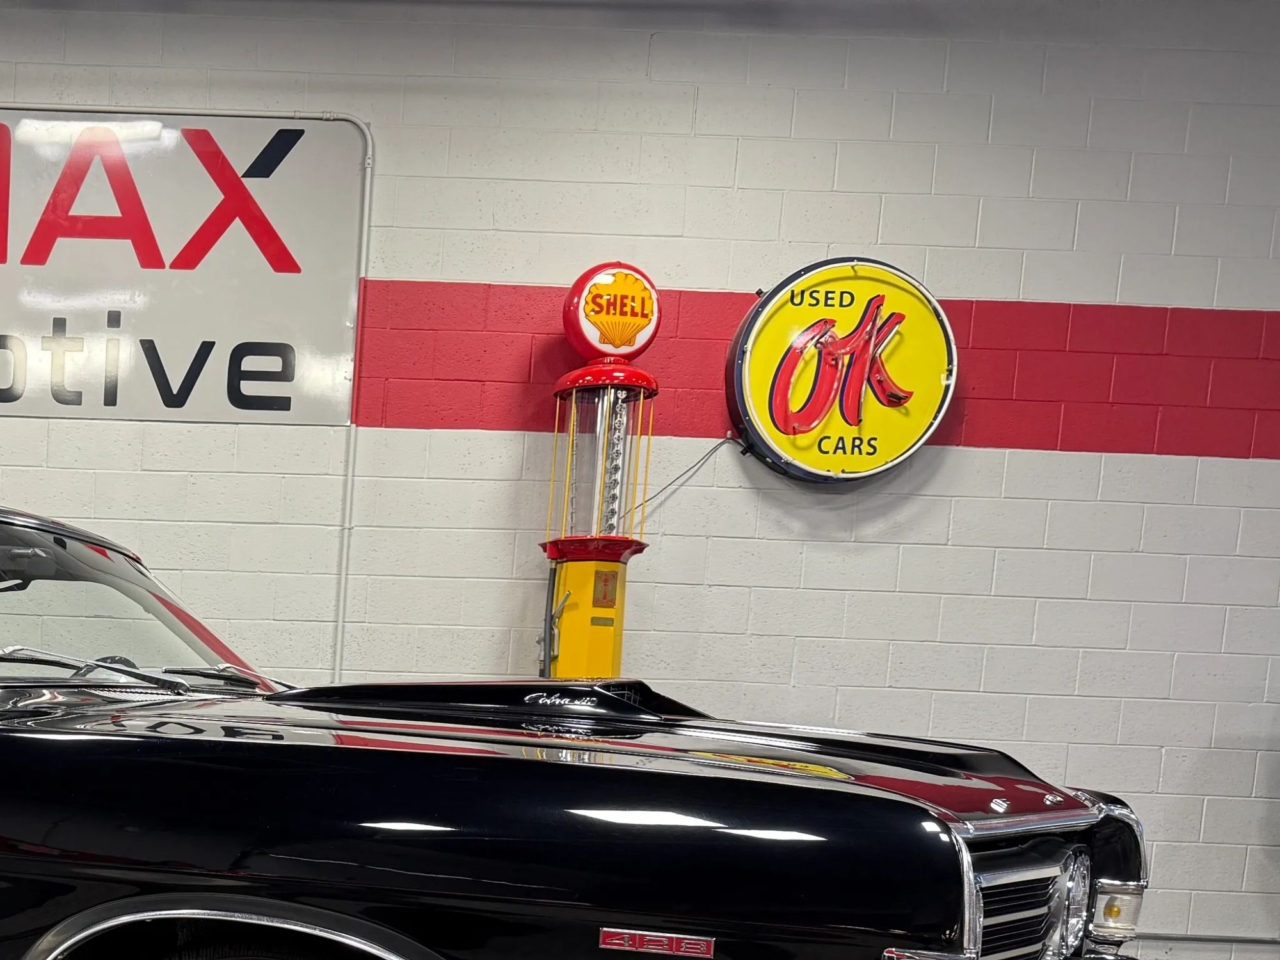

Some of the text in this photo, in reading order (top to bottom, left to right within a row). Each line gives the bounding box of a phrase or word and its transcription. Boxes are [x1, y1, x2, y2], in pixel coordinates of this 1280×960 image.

[590, 293, 649, 319] SHELL
[789, 289, 855, 308] USED
[768, 294, 915, 436] OK
[817, 435, 878, 456] CARS
